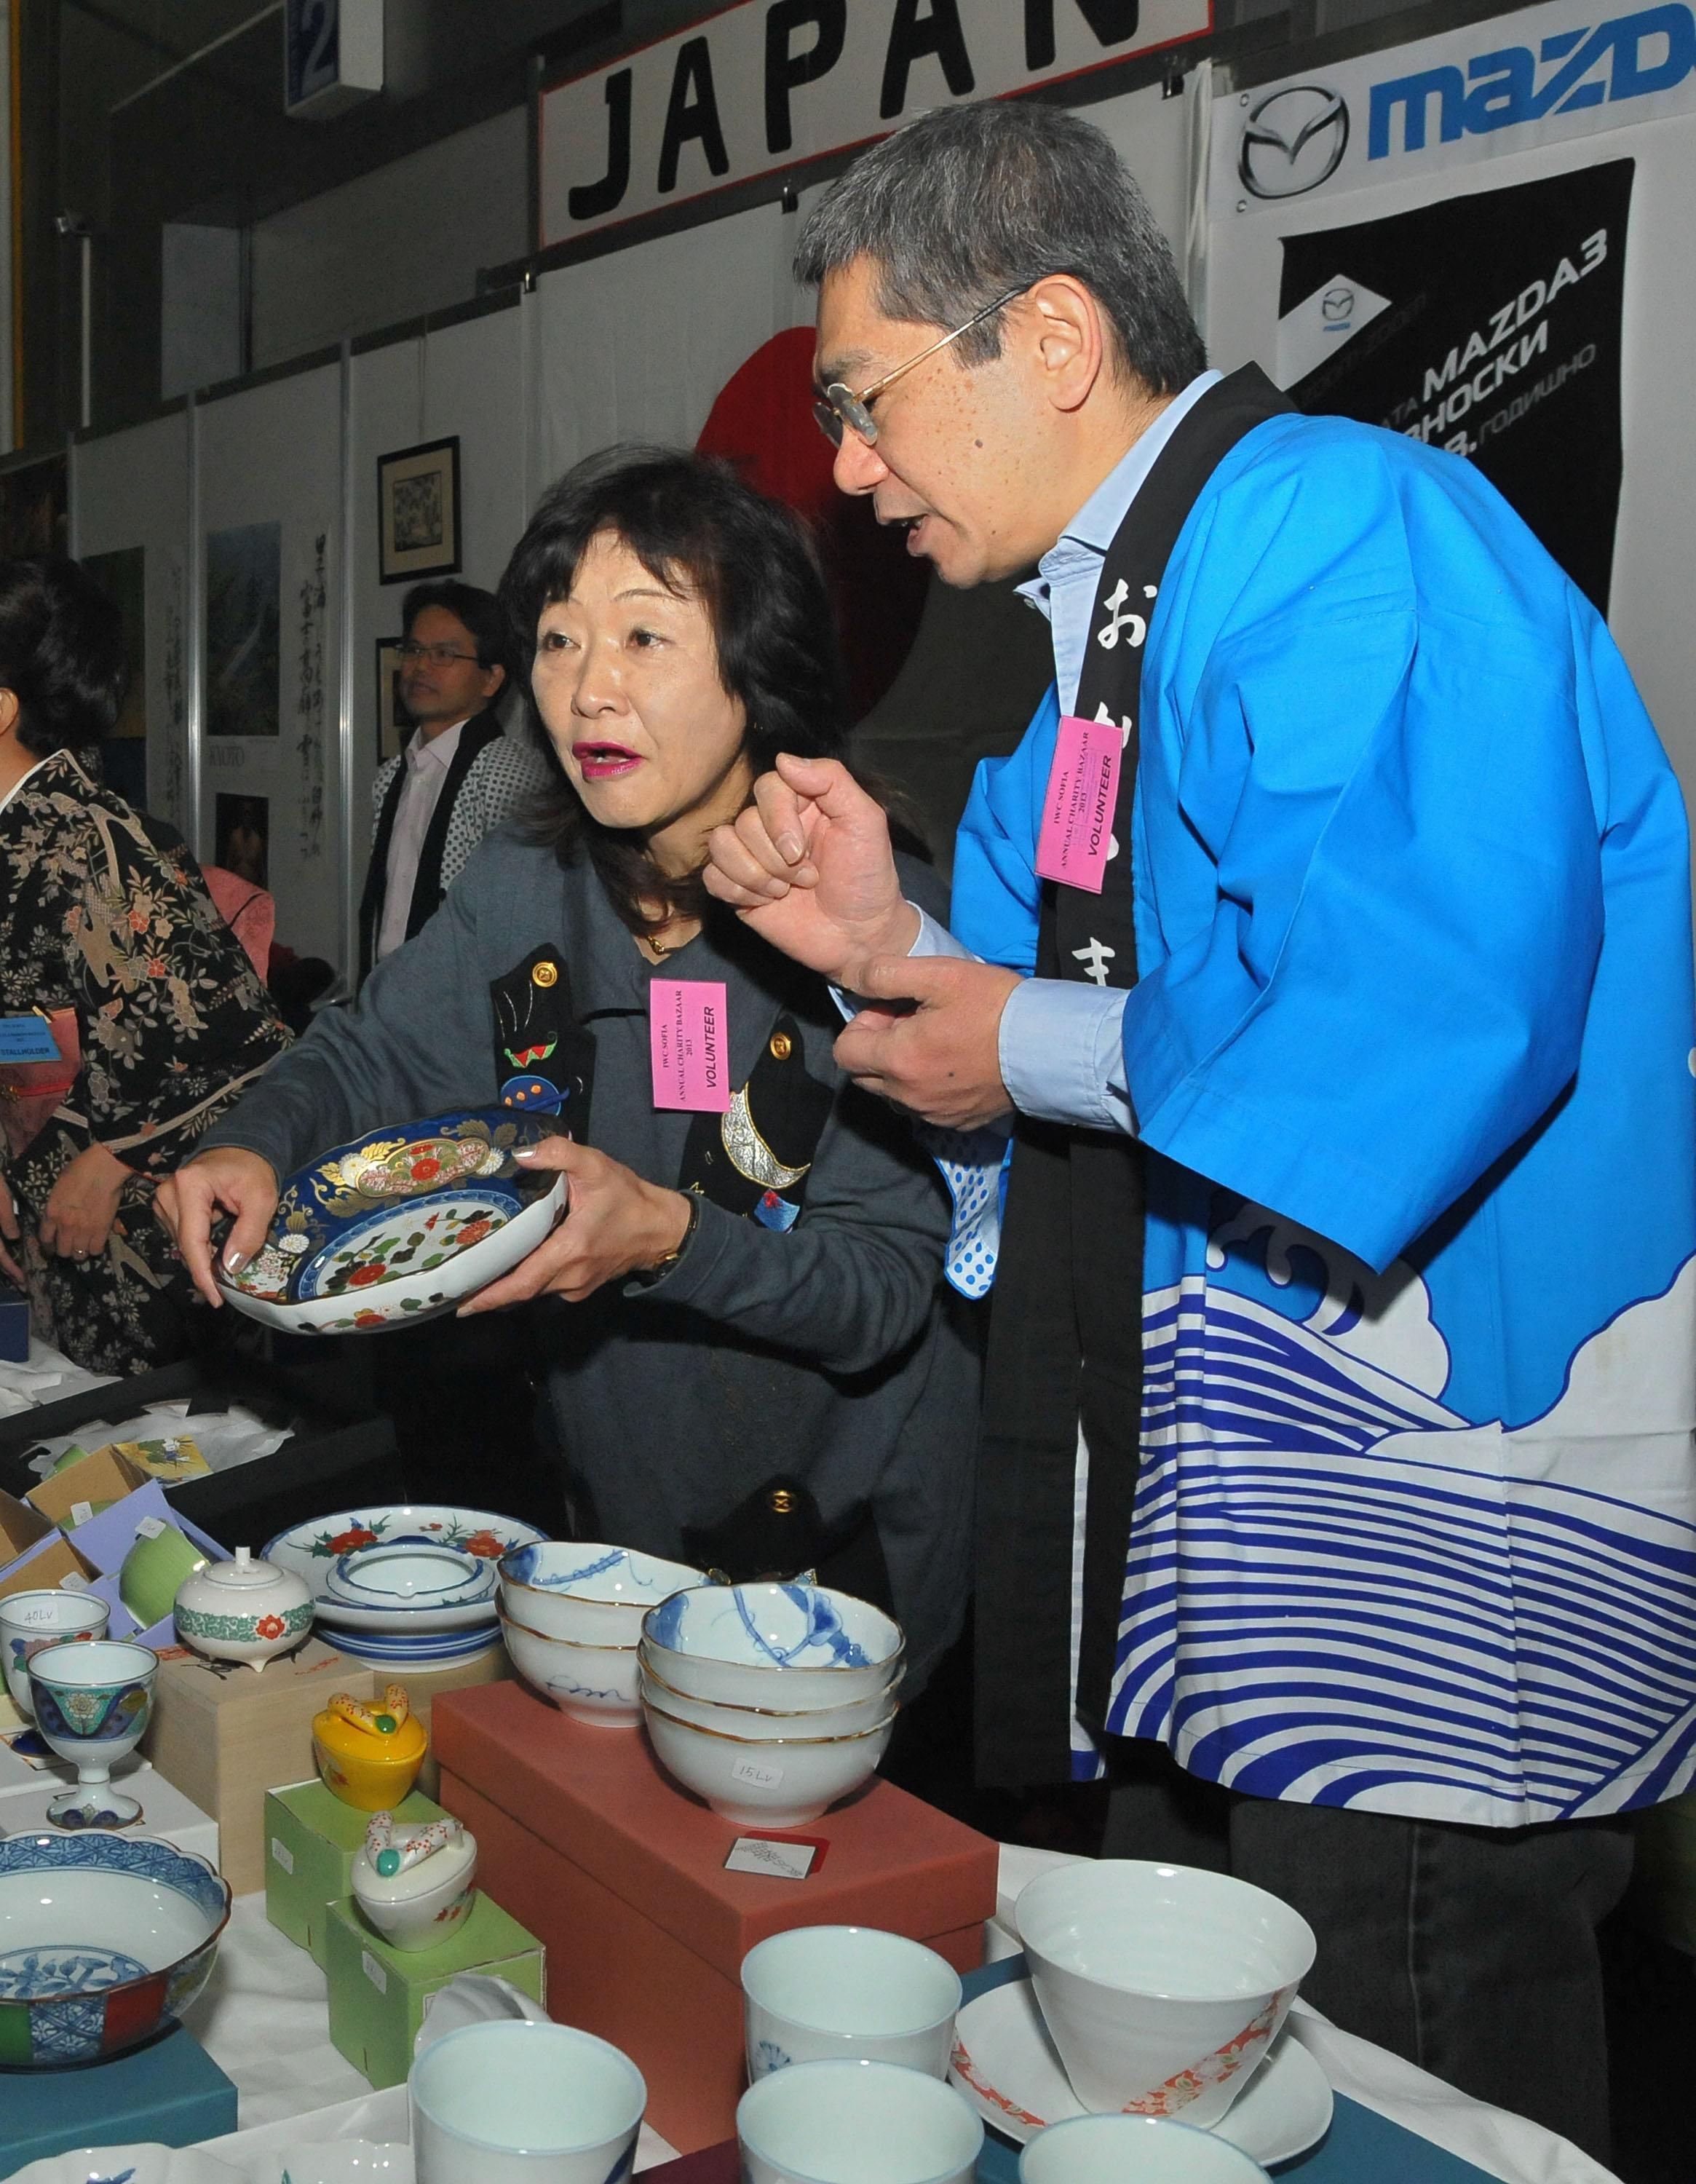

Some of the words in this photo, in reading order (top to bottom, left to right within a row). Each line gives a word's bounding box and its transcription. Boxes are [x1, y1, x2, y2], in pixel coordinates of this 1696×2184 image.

[301, 0, 336, 94] 2
[568, 0, 1140, 221] JAPAN
[1054, 804, 1063, 824] IWC
[1058, 771, 1069, 802] SOFIA
[1061, 826, 1074, 869] ANNUAL
[1068, 776, 1082, 826] CHARITY
[1077, 732, 1090, 775] BAZAAR
[1078, 792, 1087, 813] 2013
[1087, 754, 1111, 856] VOLUNTEER
[676, 1027, 684, 1067] CHARITY
[704, 1006, 717, 1088] VOLUNTEER
[677, 1068, 686, 1101] ANNUAL
